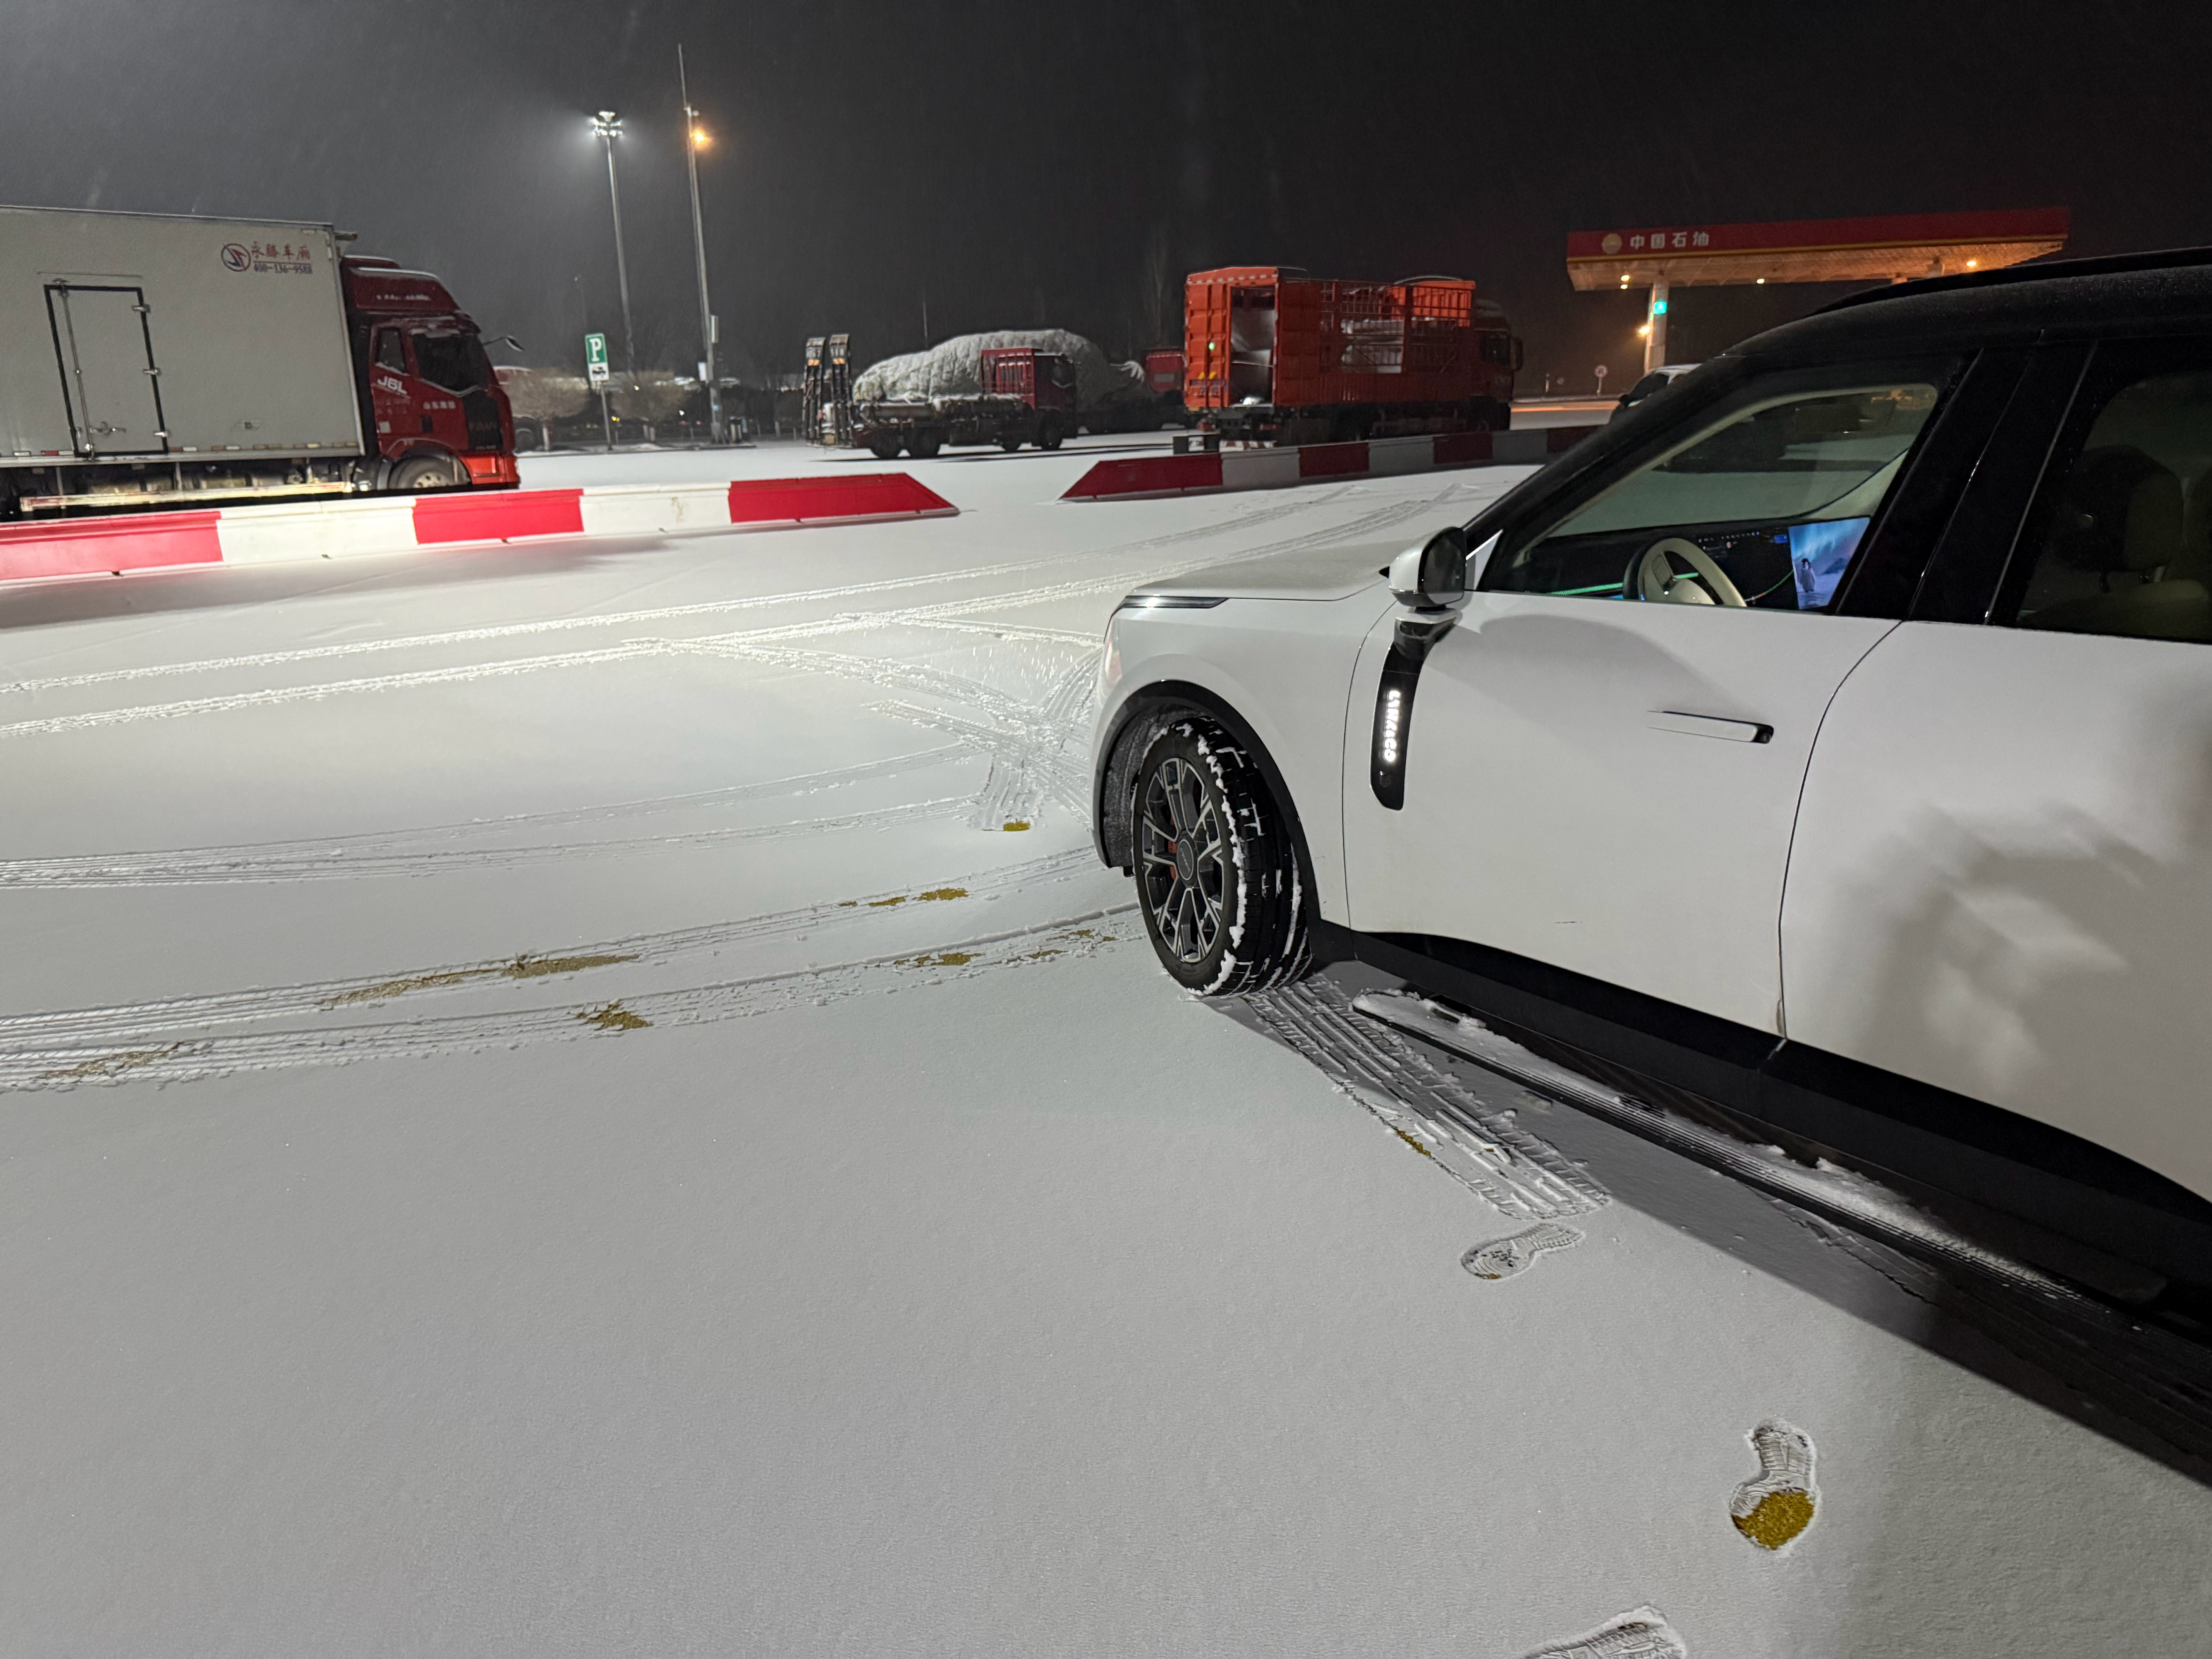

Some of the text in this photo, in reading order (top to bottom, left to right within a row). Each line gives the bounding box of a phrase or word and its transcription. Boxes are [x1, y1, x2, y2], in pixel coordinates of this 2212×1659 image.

[1630, 231, 1709, 249] 中国石油
[589, 337, 602, 362] P
[377, 375, 408, 395] JBL
